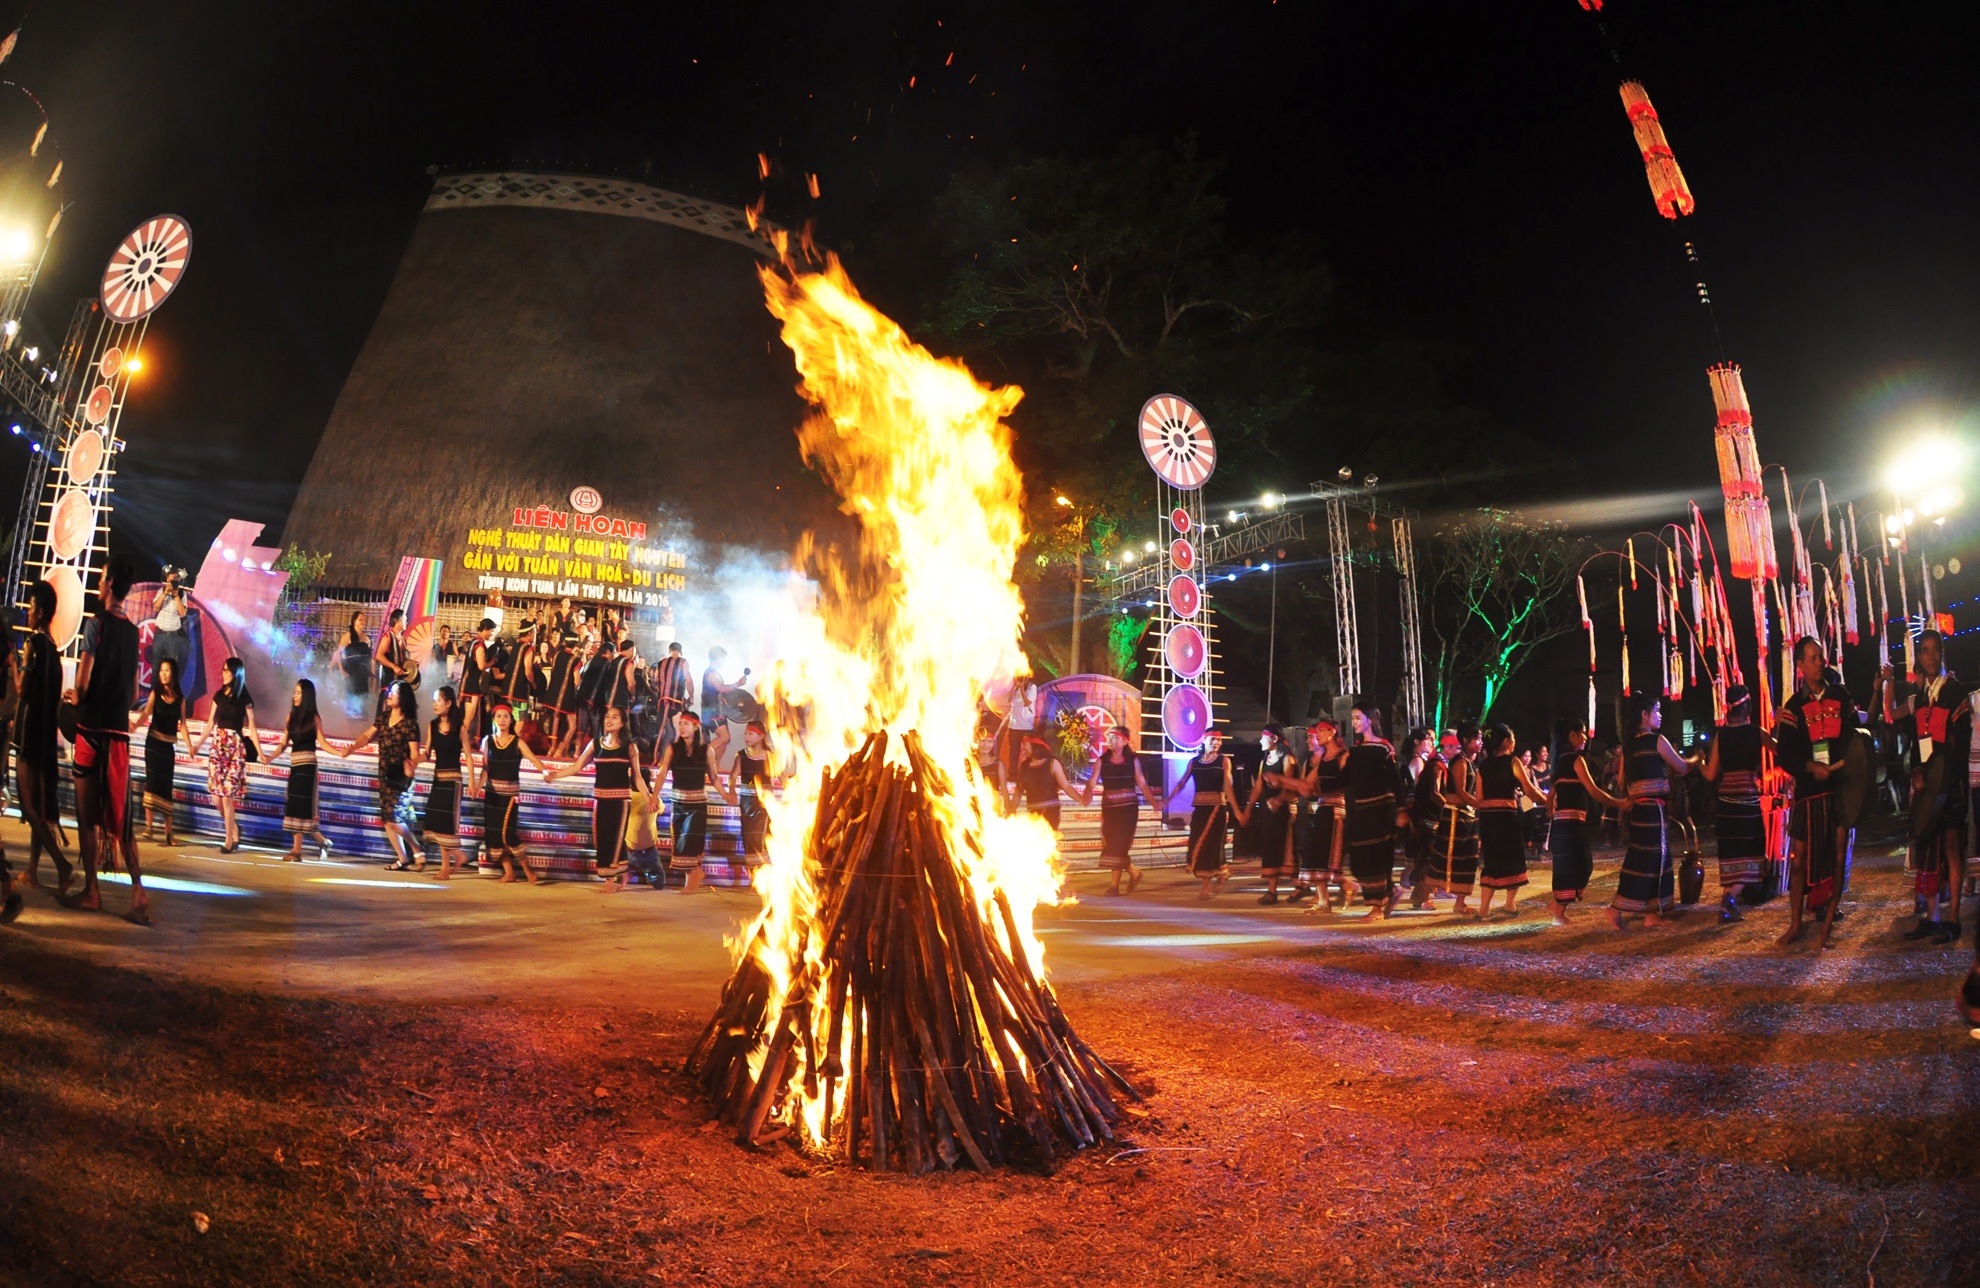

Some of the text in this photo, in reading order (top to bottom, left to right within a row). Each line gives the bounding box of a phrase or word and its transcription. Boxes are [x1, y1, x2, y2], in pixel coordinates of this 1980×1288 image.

[513, 505, 646, 540] LIÊN HOAN
[468, 528, 685, 568] NGHỆ THUẬT DÂN GIAN TÂY NGUYÊN
[464, 546, 492, 570] GẮN
[496, 551, 519, 572] VỚI
[524, 553, 559, 576] TUẦN
[564, 558, 592, 579] VĂN
[633, 569, 651, 587] DU
[656, 572, 685, 592] LỊCH
[478, 572, 669, 607] TỈNH KON TUM LẦN THỨ 3 NĂM 2016
